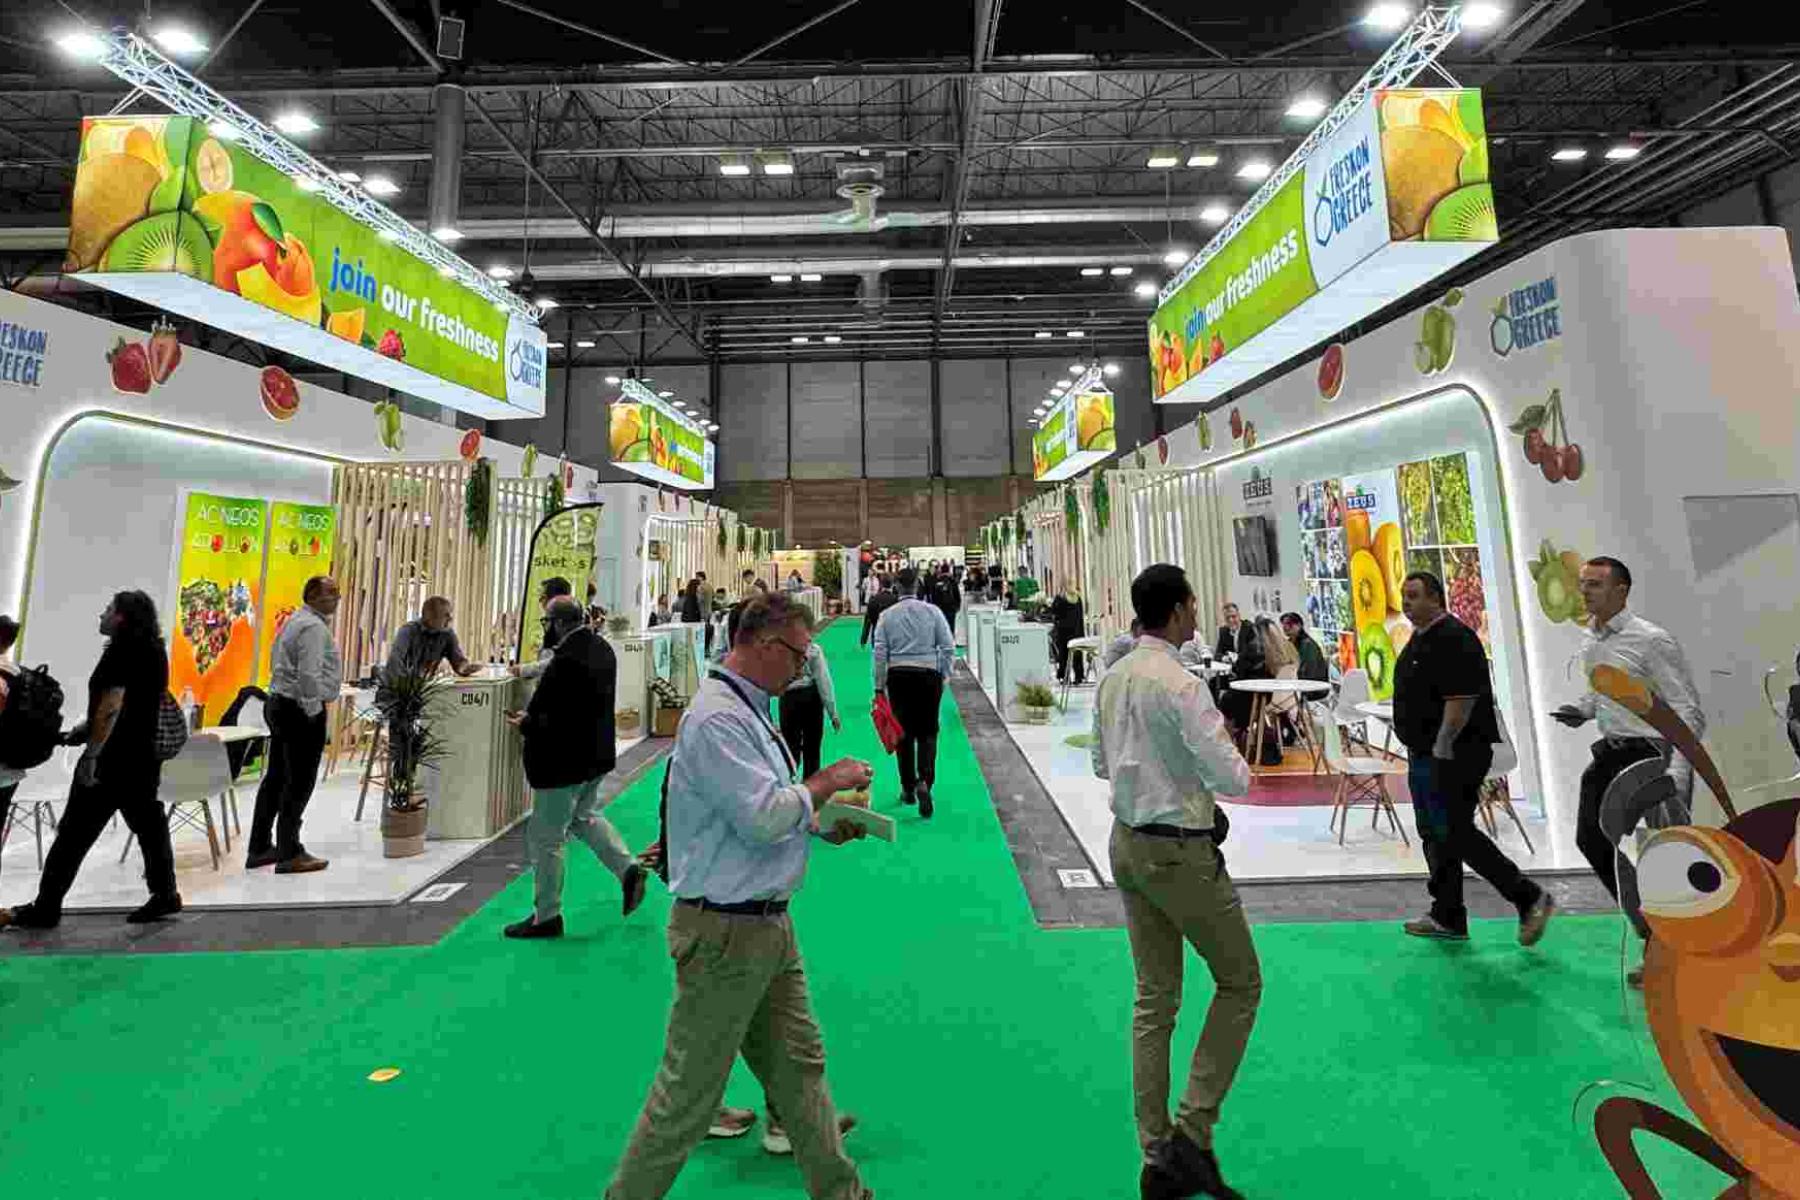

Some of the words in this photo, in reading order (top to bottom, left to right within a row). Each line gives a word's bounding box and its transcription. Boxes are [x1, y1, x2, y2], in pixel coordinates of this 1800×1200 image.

[1333, 171, 1372, 234] GREECE
[329, 247, 376, 302] join
[381, 284, 416, 322] our
[420, 297, 499, 363] freshness
[1205, 291, 1225, 325] our
[1226, 229, 1298, 309] freshness
[1513, 306, 1561, 350] GREECE
